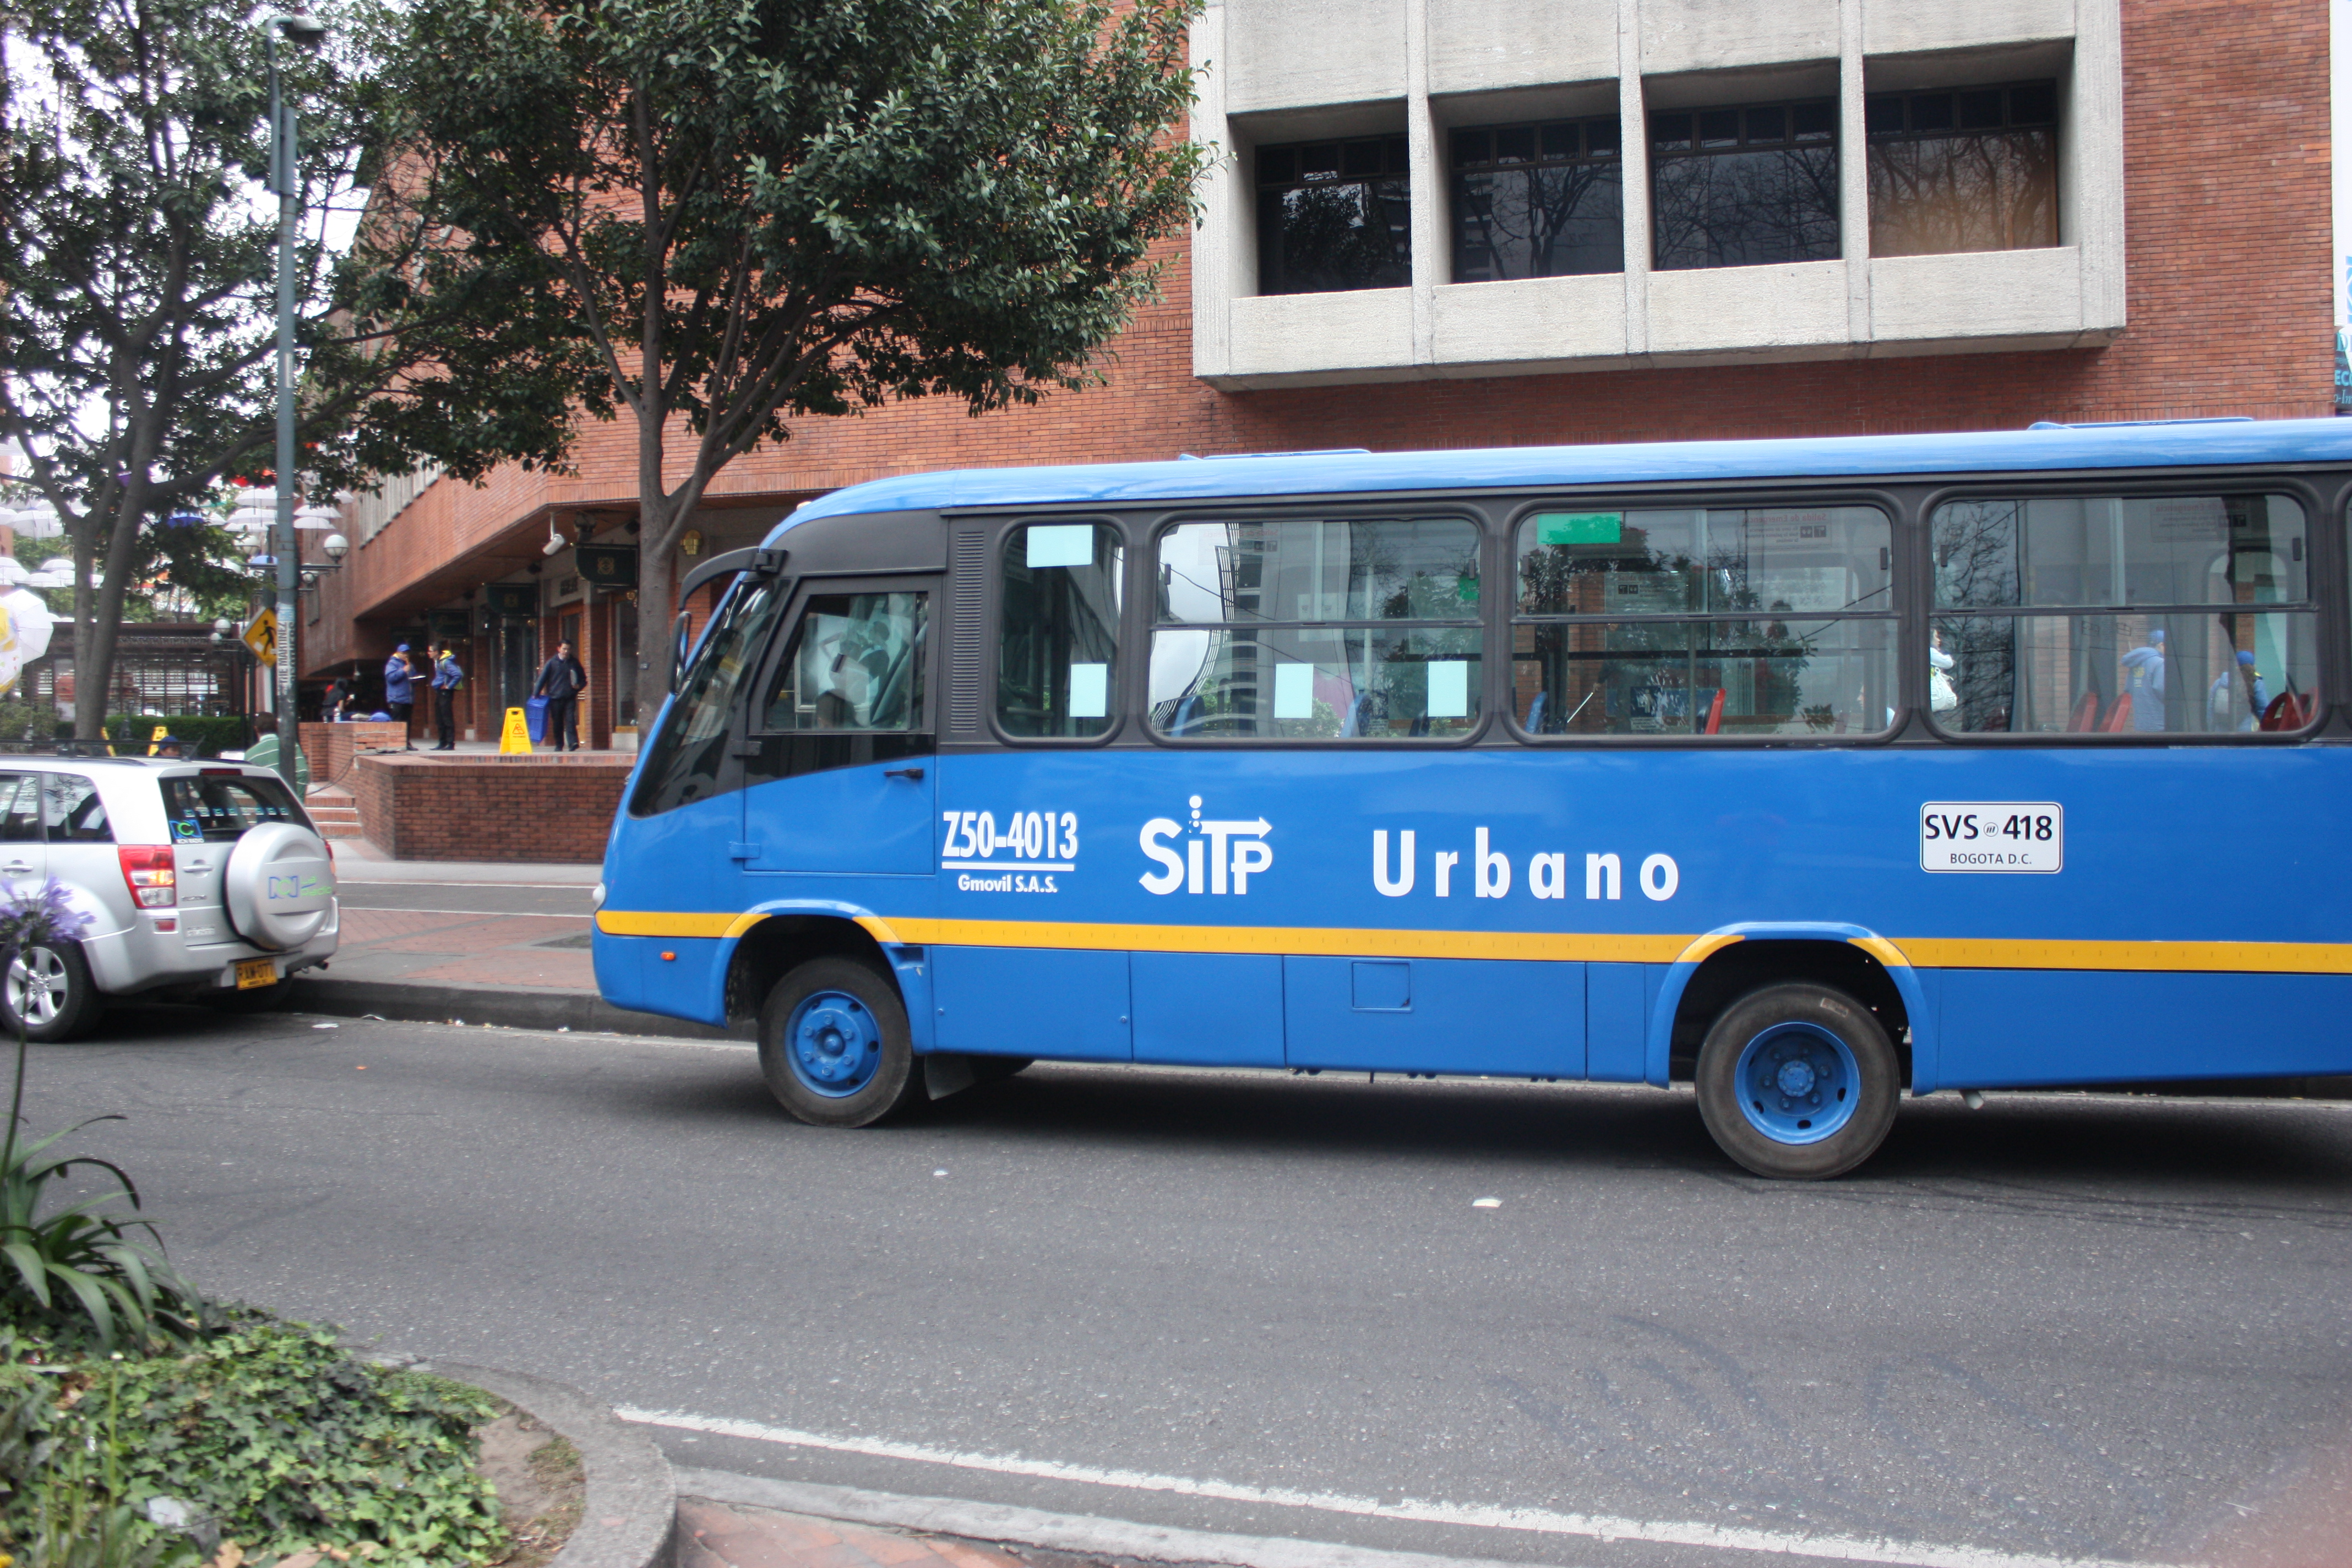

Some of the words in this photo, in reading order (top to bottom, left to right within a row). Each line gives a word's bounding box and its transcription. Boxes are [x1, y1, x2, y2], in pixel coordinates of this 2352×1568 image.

[941, 812, 1077, 859] Z50-4013
[1925, 814, 1979, 840] SVS
[2002, 815, 2052, 841] 418
[1373, 827, 1679, 901] Urbano
[1950, 853, 2004, 864] BOGOTA
[2008, 853, 2032, 864] D.C.
[958, 874, 1011, 892] Gmovil
[1015, 875, 1058, 893] S.A.S.
